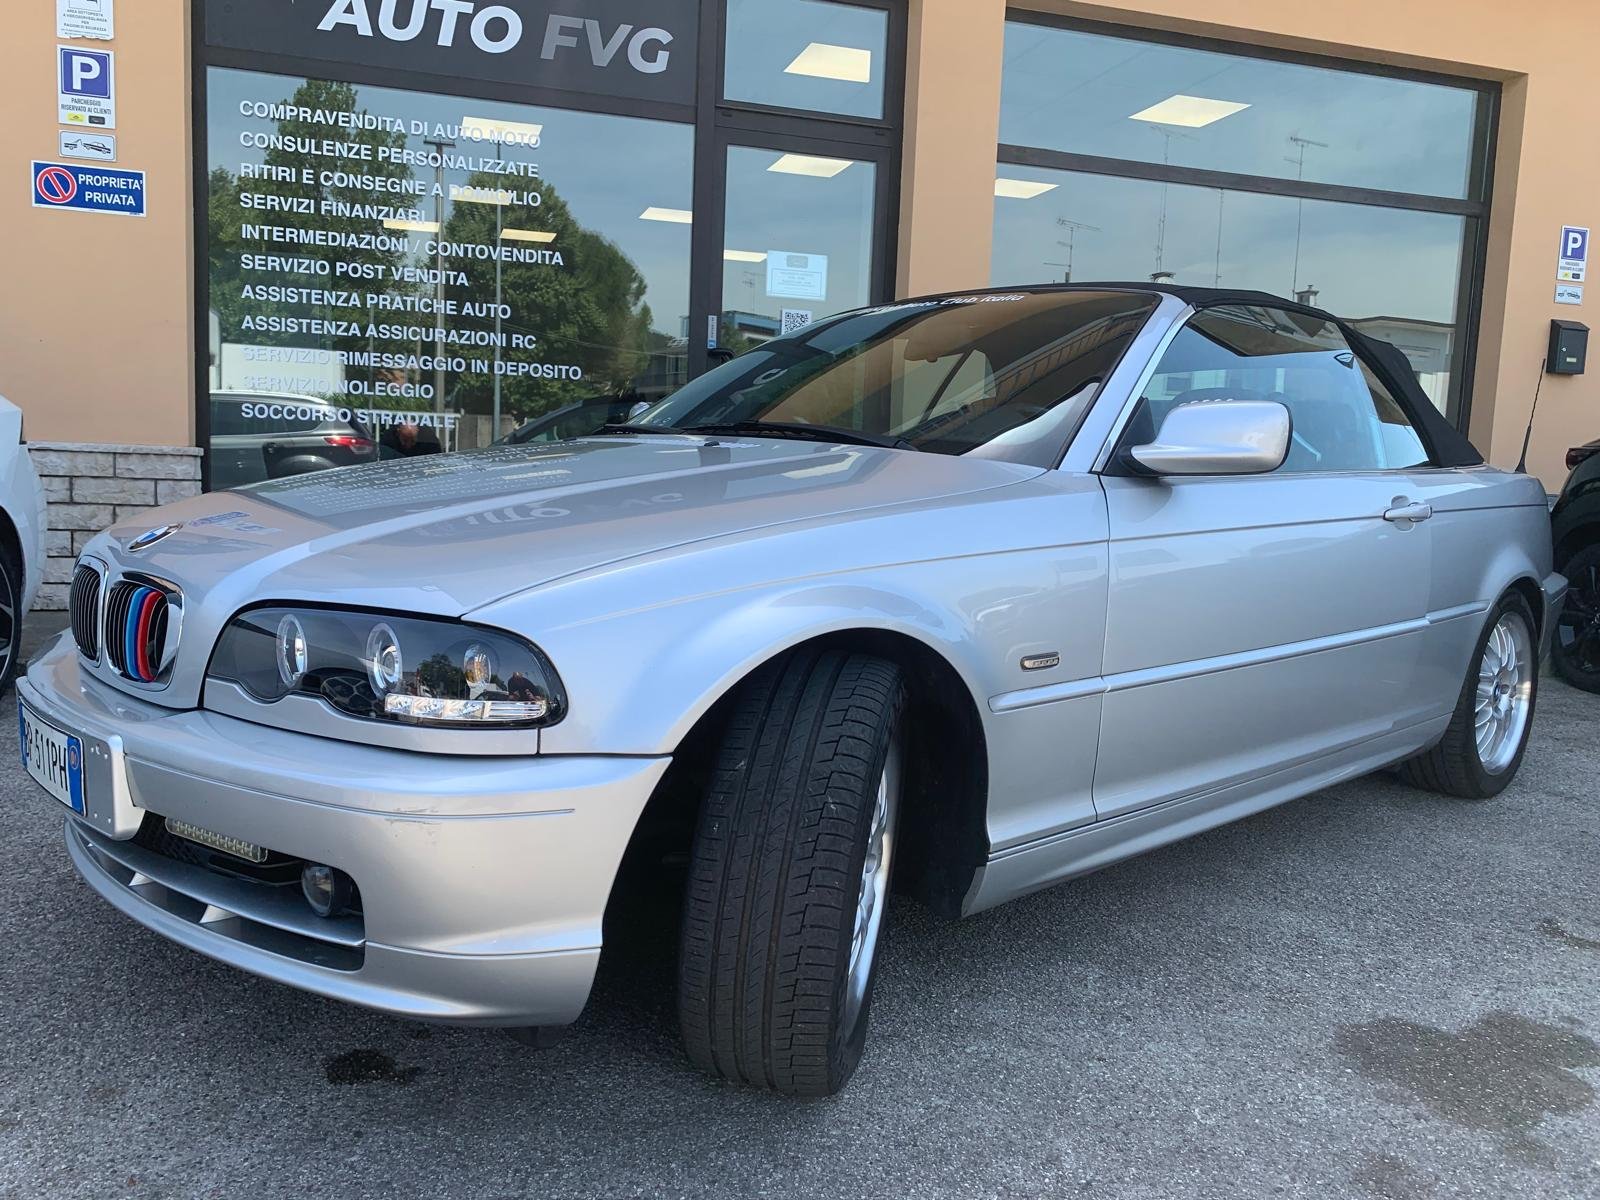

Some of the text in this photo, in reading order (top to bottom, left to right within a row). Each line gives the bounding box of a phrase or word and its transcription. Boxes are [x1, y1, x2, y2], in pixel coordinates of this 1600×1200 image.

[316, 0, 674, 74] AUTO FVG
[71, 55, 101, 90] P
[239, 100, 541, 149] COMPRAVENDITA DI AUTO MOTO
[239, 131, 539, 178] CONSULENZE PERSONALIZZATE
[78, 174, 143, 190] PROPRIETA'
[85, 192, 136, 206] PRIVATA
[240, 162, 542, 207] RITIRI E CONSEGNE A DOMICILIO
[239, 192, 425, 225] SERVIZI FINANZIARI
[241, 223, 564, 266] INTERMEDIAZIONI / CONTOVENDITA
[1566, 231, 1583, 257] P
[240, 254, 469, 287] SERVIZIO POST VENDITA
[241, 284, 512, 319] ASSISTENZA PRATICHE AUTO
[241, 315, 537, 349] ASSISTENZA ASSICURAZIONI RC
[241, 346, 582, 381] SERVIZIO RIMESSAGGIO IN DEPOSITO
[241, 375, 434, 399] SERVIZIO NOLEGGIO
[241, 403, 456, 429] SOCCORSO STRADALE
